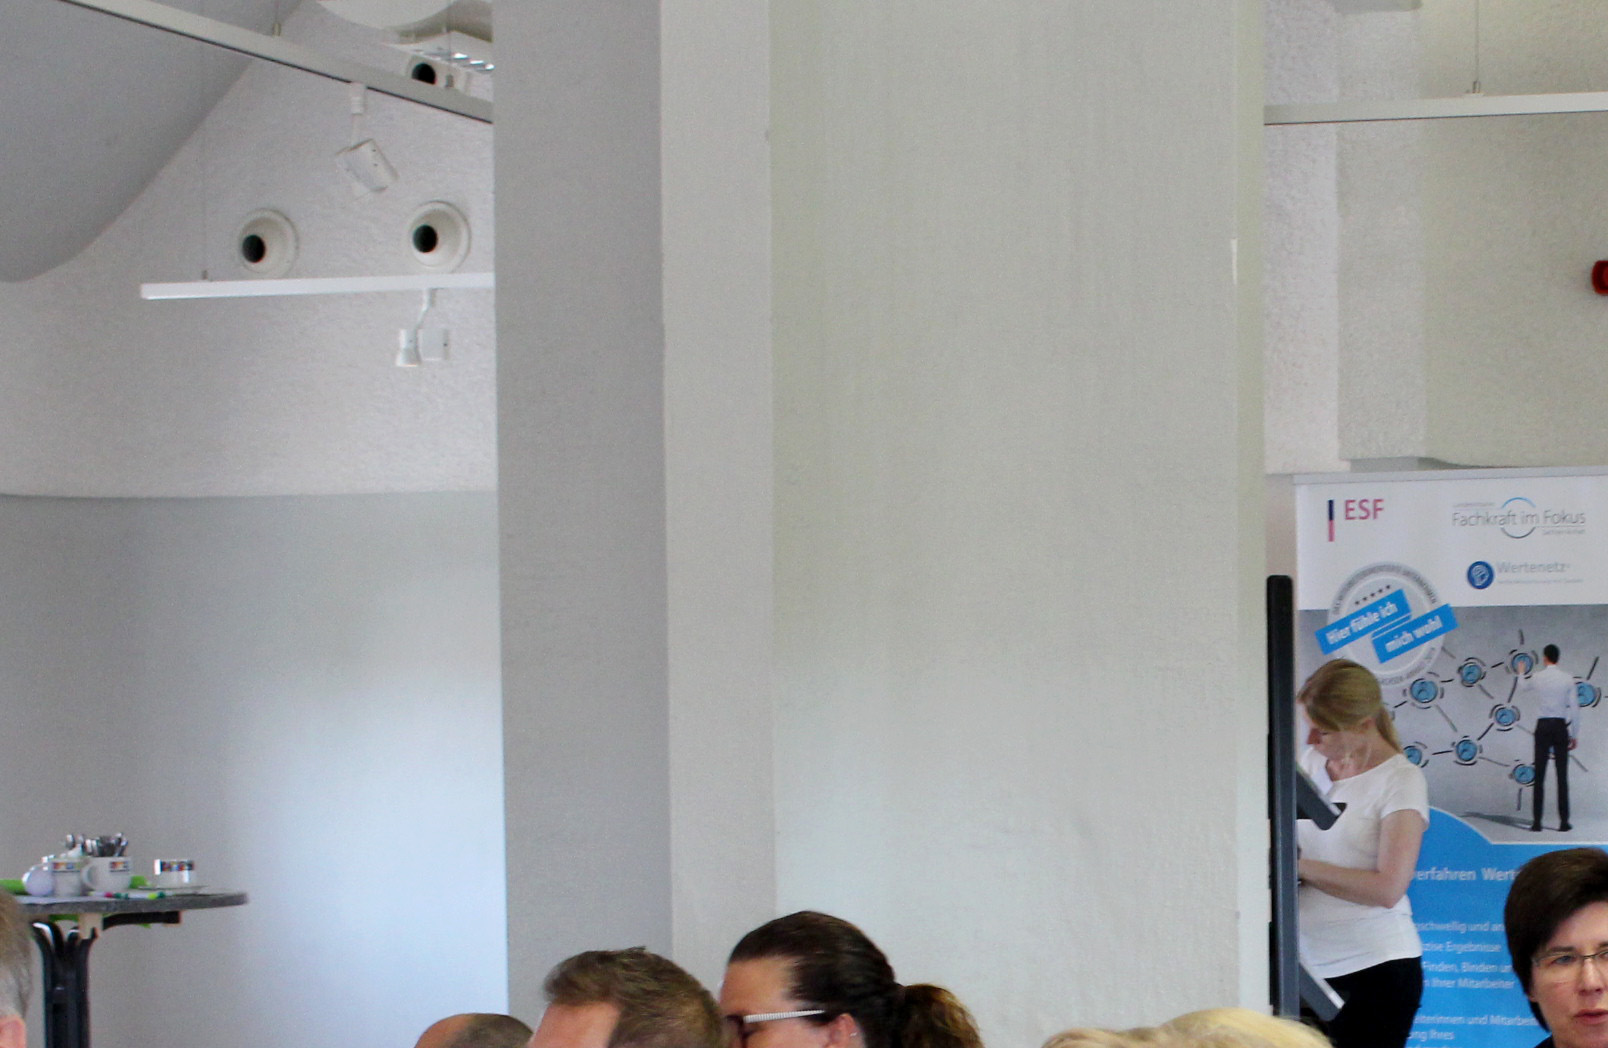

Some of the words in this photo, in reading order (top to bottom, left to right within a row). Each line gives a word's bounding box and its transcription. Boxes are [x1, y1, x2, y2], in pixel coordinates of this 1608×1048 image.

[1345, 499, 1384, 520] ESF
[1452, 510, 1516, 526] Fachkraft
[1521, 509, 1538, 525] im
[1543, 508, 1586, 525] Fokus
[1325, 626, 1352, 645] Hier
[1350, 610, 1381, 633] fühle
[1379, 601, 1398, 618] ich
[1385, 630, 1414, 652] mich
[1412, 615, 1443, 638] wohl
[1416, 866, 1477, 880] erfahren
